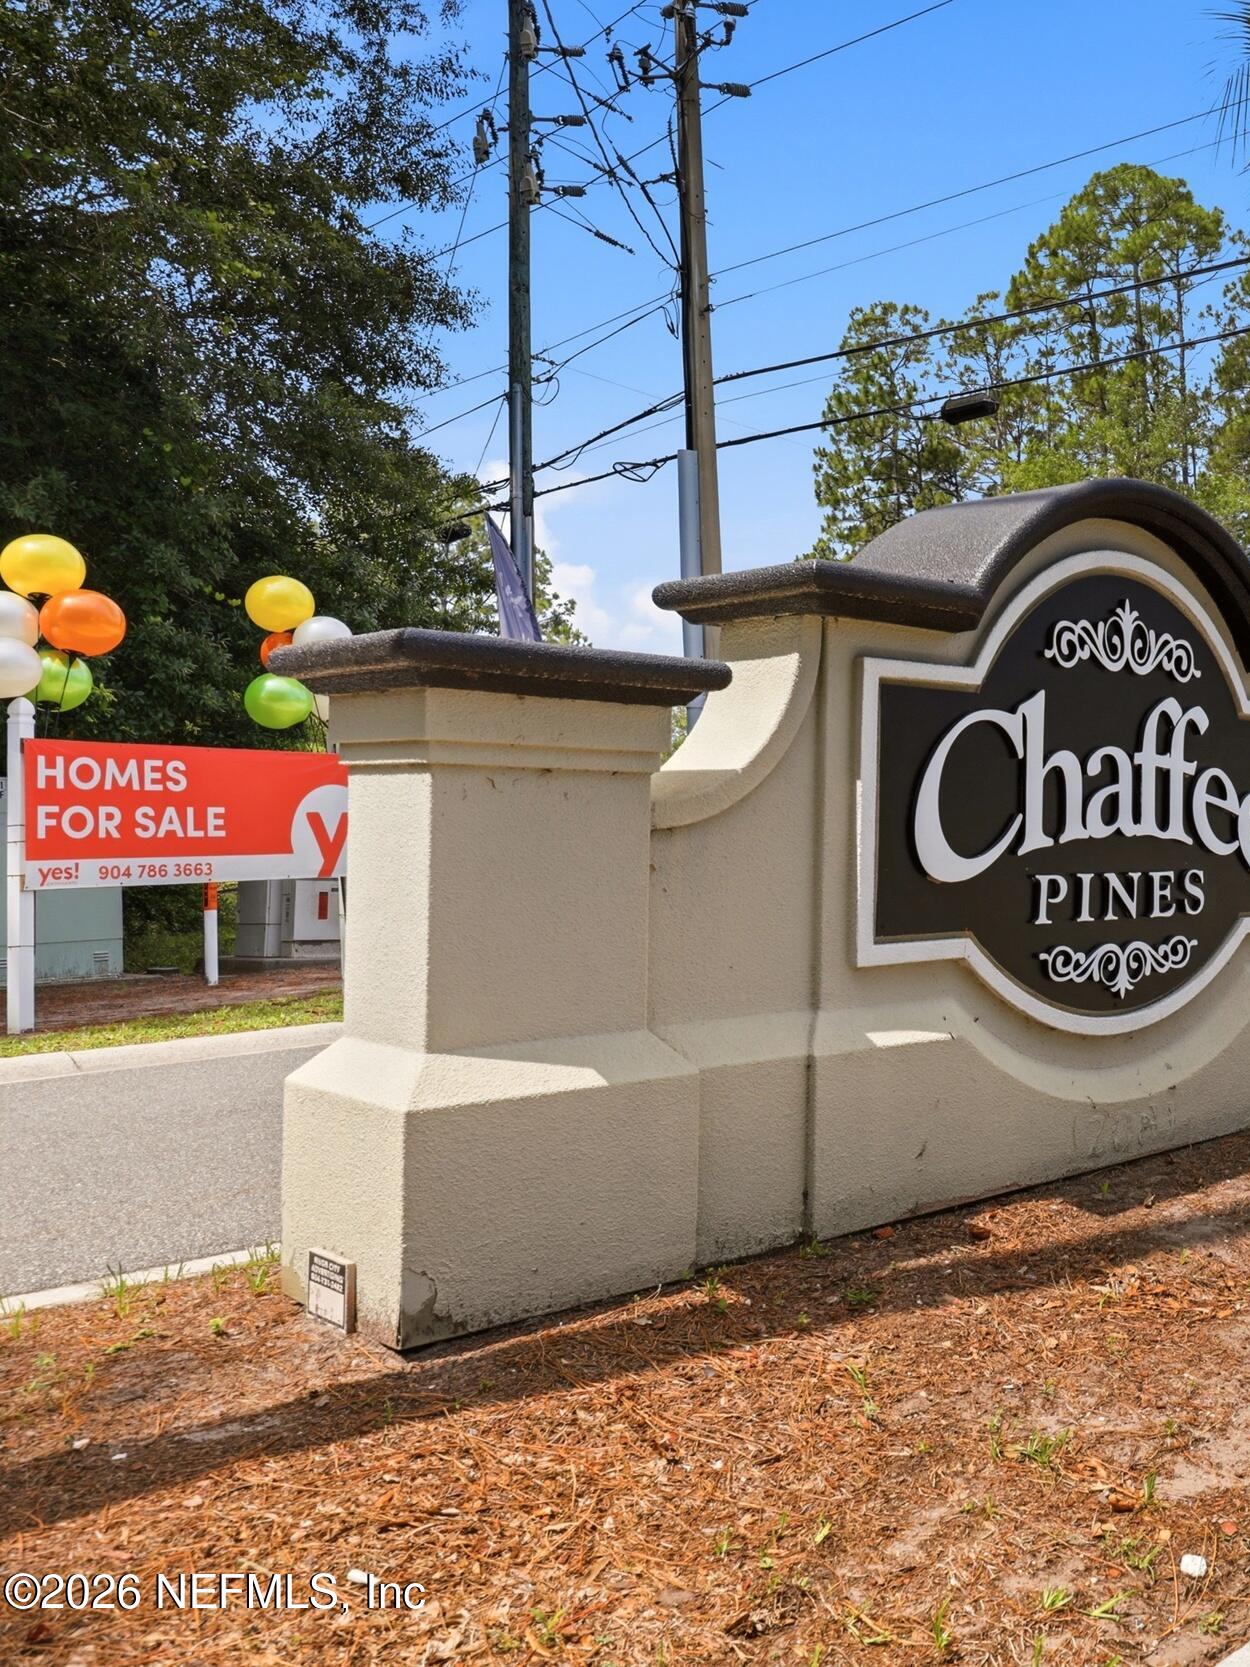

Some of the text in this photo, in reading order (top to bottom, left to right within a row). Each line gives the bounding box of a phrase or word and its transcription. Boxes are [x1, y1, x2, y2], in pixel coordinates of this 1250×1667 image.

[36, 755, 188, 793] HOMES
[36, 805, 227, 839] FOR SALE
[38, 862, 80, 887] yes!
[98, 862, 213, 880] 904 786 3663
[1034, 869, 1206, 925] PINES
